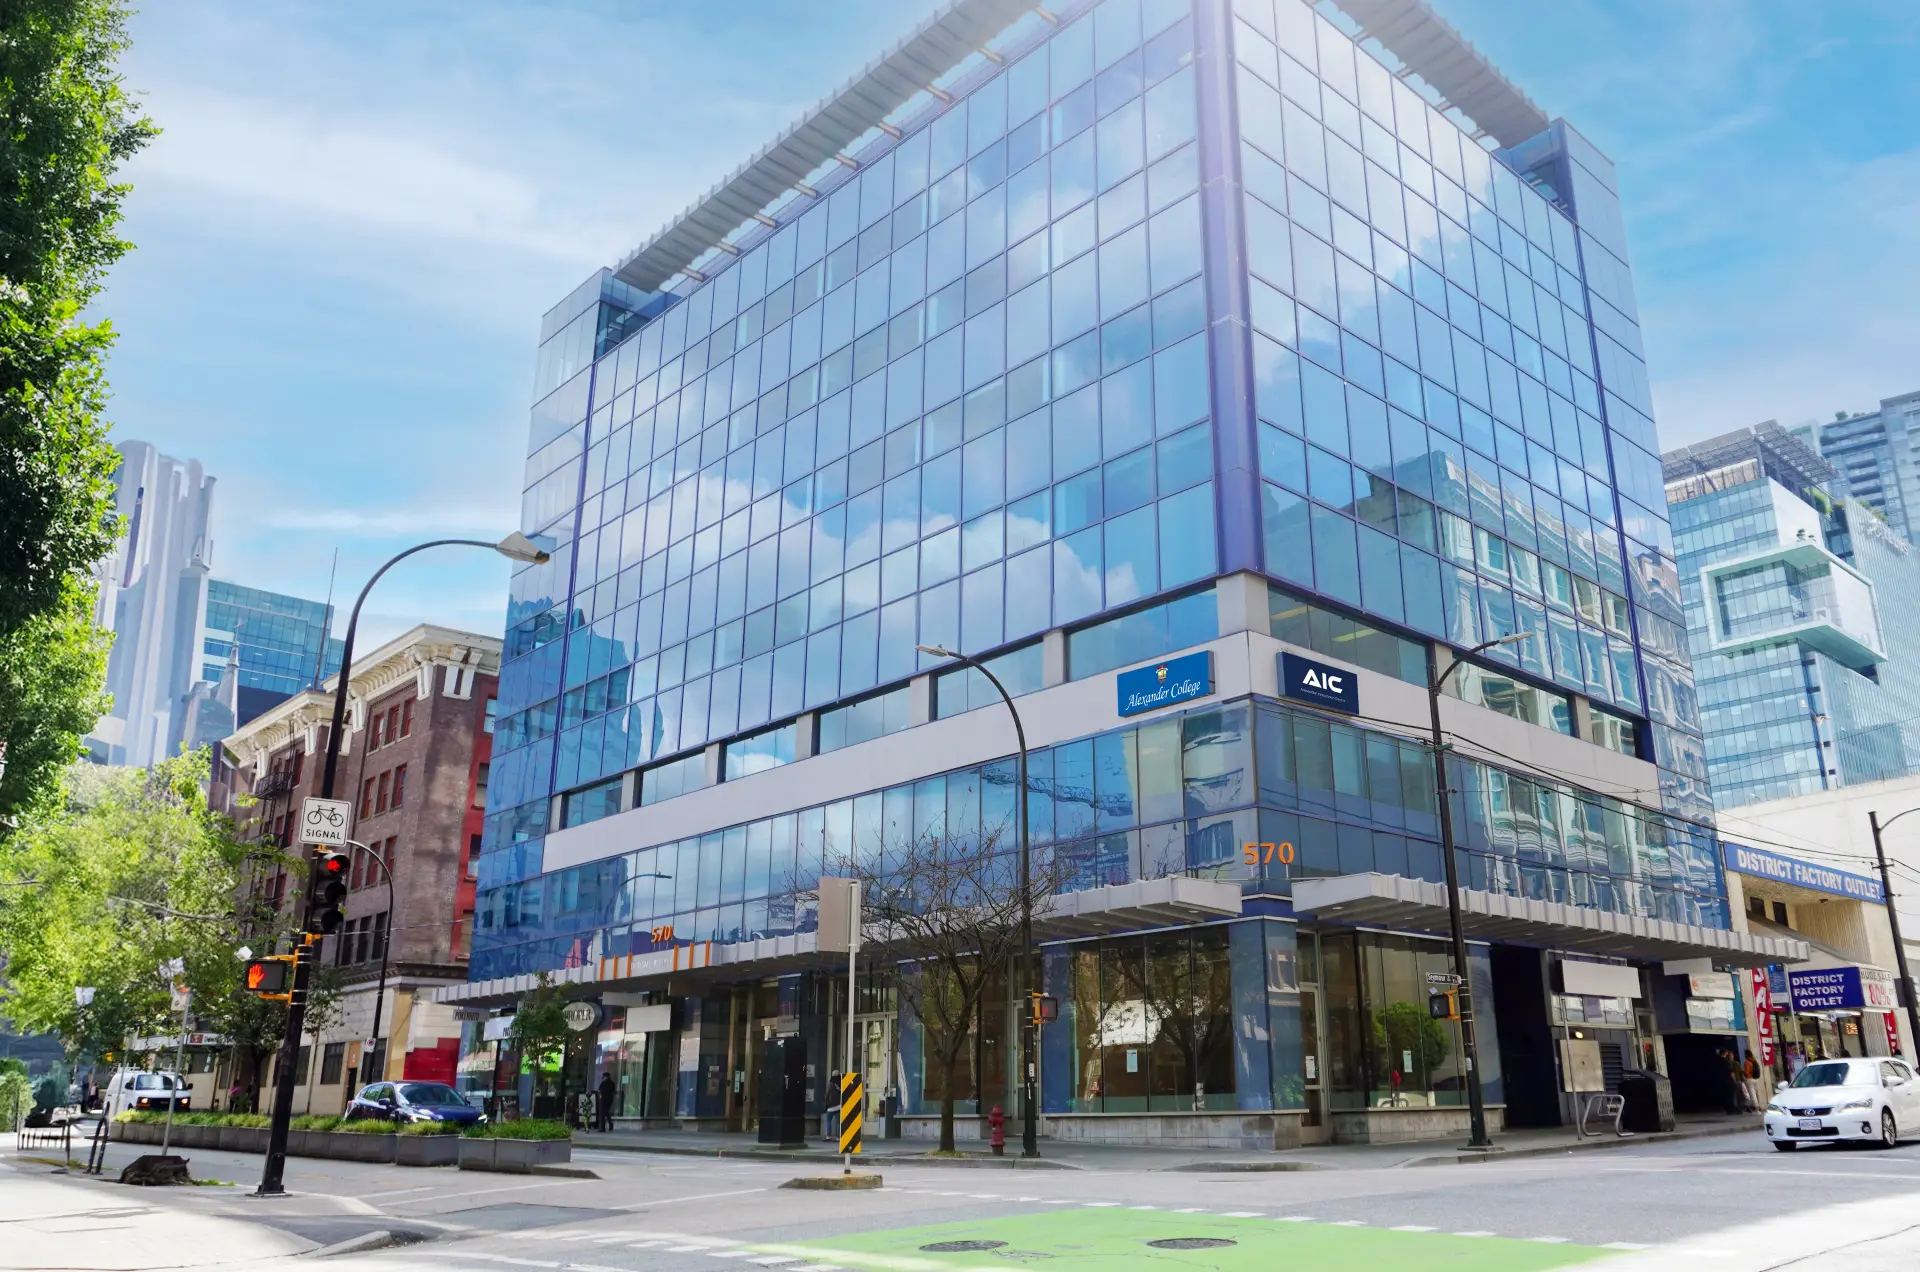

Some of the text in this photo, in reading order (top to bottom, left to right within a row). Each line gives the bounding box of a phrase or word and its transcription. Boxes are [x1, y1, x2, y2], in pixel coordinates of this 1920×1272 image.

[1302, 668, 1344, 694] AIC
[1125, 679, 1201, 711] Alexander College
[305, 829, 341, 840] SIGNAL
[1243, 842, 1295, 865] 570
[1737, 849, 1881, 900] DISTRICT FACTORY OUTLET
[1792, 973, 1845, 986] DISTRICT
[1793, 985, 1845, 997] FACTORY
[1800, 996, 1843, 1008] OUTLET
